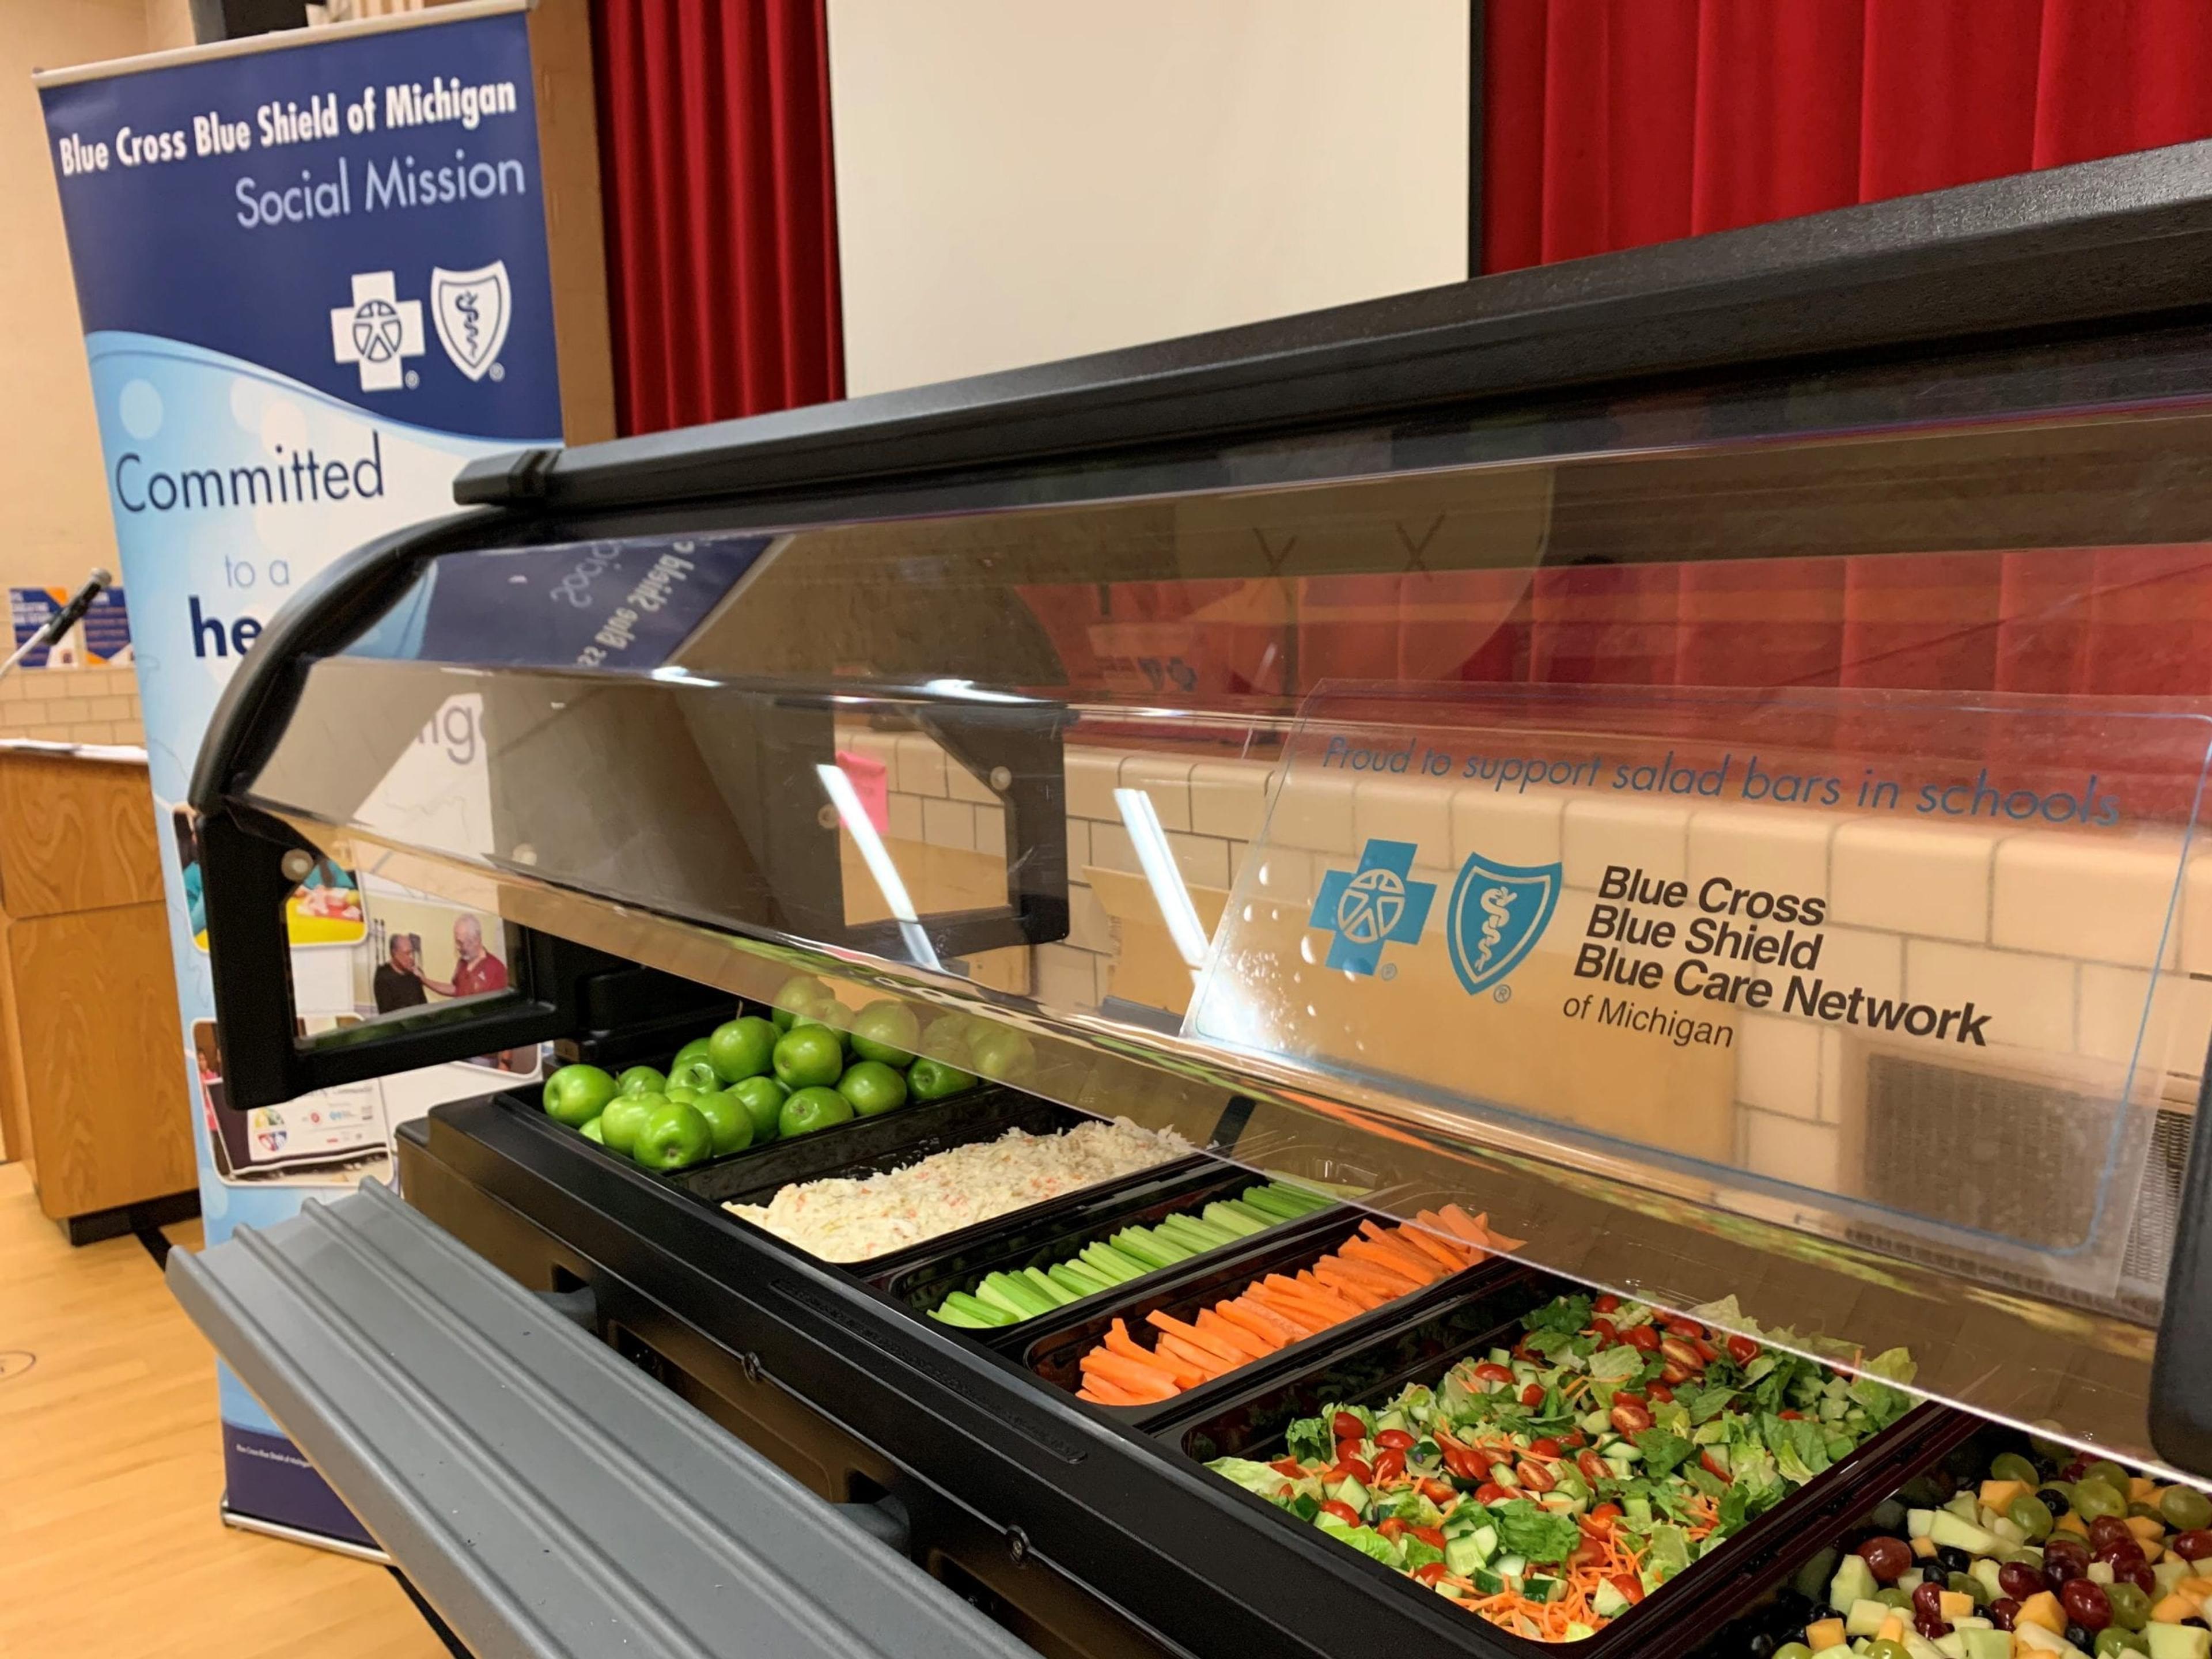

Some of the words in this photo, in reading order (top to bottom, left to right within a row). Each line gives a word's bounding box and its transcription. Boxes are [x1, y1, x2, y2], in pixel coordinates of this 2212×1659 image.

[59, 135, 109, 176] Blue
[116, 126, 187, 169] Cross
[194, 111, 251, 158] Blue
[257, 93, 339, 147] Shield
[346, 86, 376, 133] of
[385, 77, 516, 130] Michigan
[236, 157, 350, 229] Social
[365, 149, 526, 211] Mission
[116, 430, 384, 513] Committed
[225, 555, 255, 588] to
[270, 559, 289, 586] a
[1323, 736, 1417, 774] Proud
[1421, 749, 1451, 777] to
[1463, 754, 1602, 794] support
[1612, 751, 1731, 797] salad
[1741, 756, 1841, 805] bars
[1858, 770, 1900, 809] in
[1916, 768, 2120, 827] schools
[1599, 866, 1687, 908] Blue
[1698, 877, 1826, 926] Cross
[1586, 904, 1675, 949] Blue
[1685, 917, 1823, 971] Shield
[1563, 995, 1591, 1020] of
[1598, 998, 1733, 1047] Michigan
[1574, 943, 1663, 990] Blue
[1673, 959, 1772, 1008] Care
[1782, 975, 1993, 1046] Network
